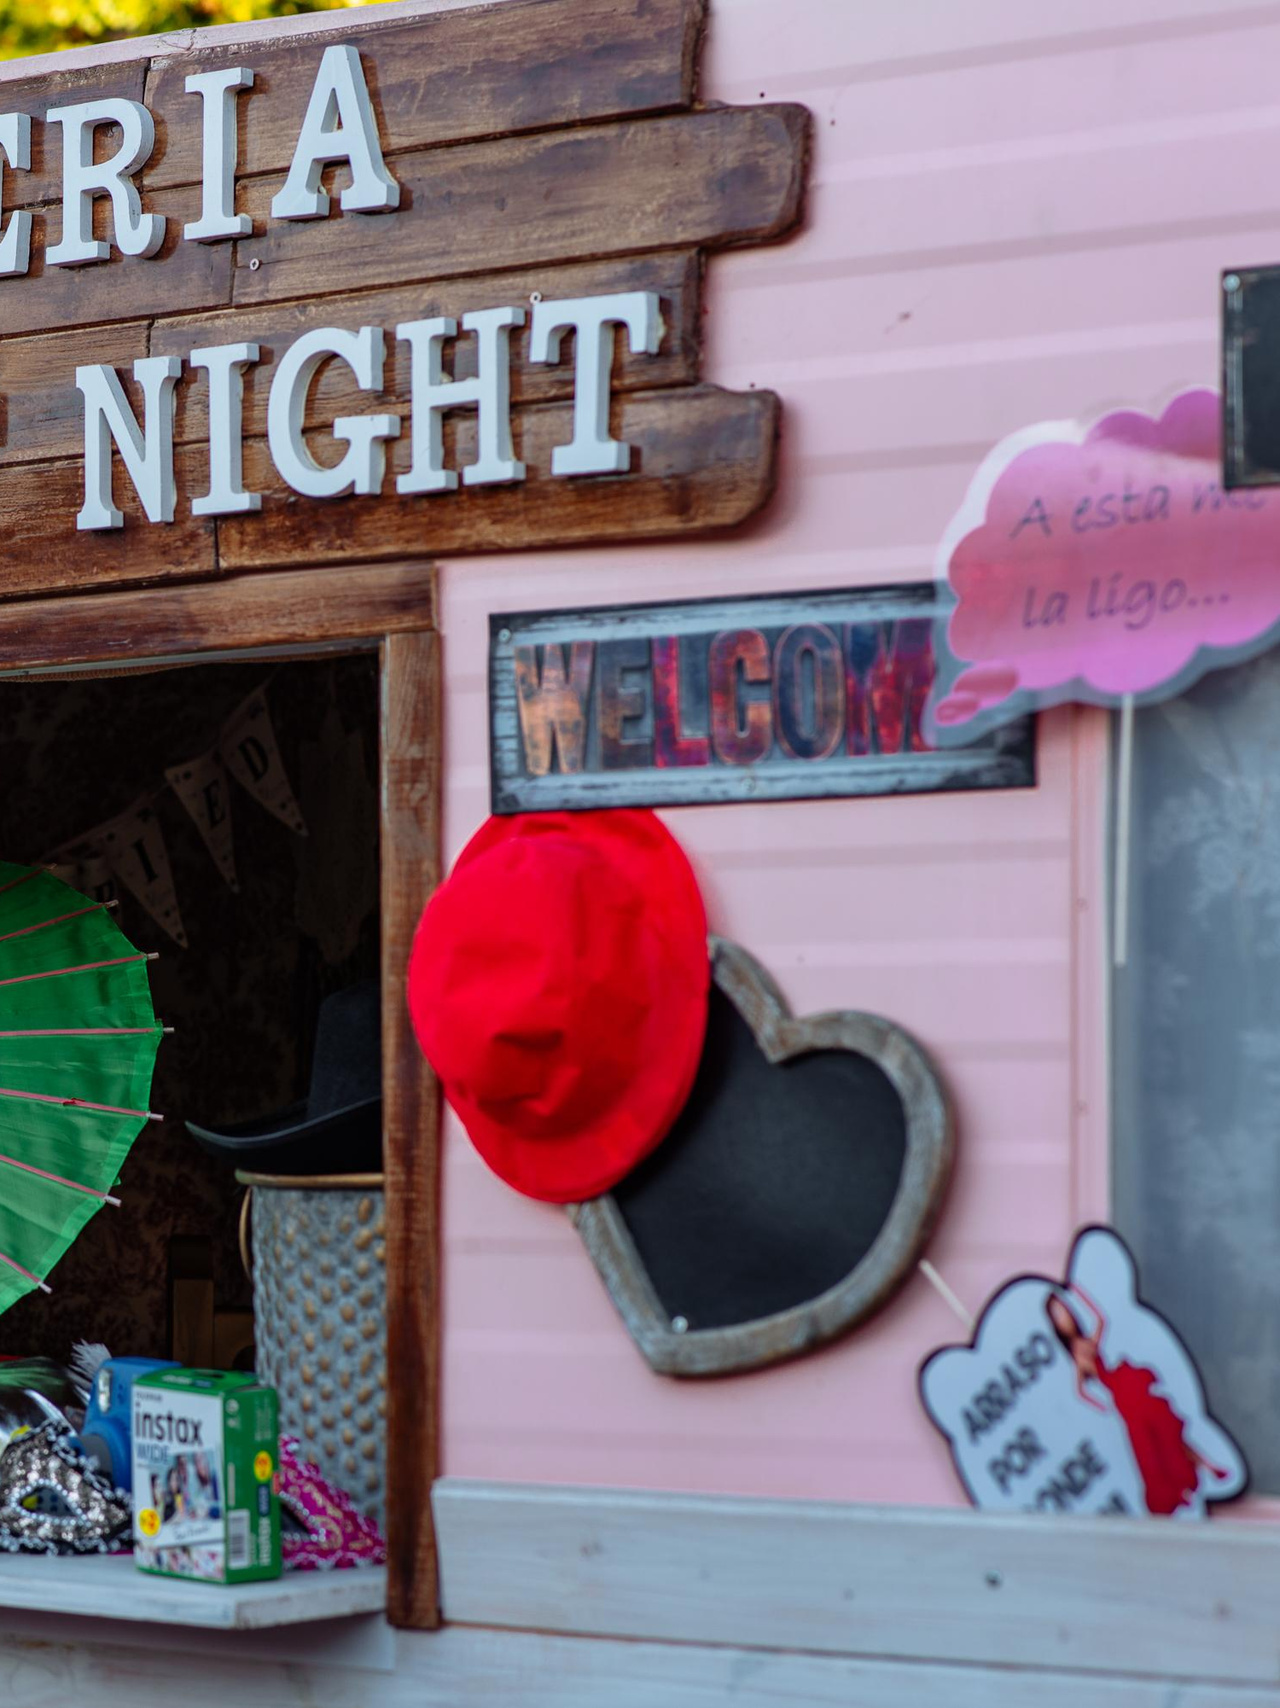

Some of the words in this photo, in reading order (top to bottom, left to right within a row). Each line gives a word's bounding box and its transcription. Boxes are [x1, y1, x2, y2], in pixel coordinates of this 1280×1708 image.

[76, 290, 661, 532] NIGHT
[1008, 496, 1053, 539] A
[514, 617, 937, 777] WELCOM
[135, 1402, 203, 1447] instax
[987, 1425, 1048, 1498] POR
[1023, 1437, 1108, 1512] ONDE
